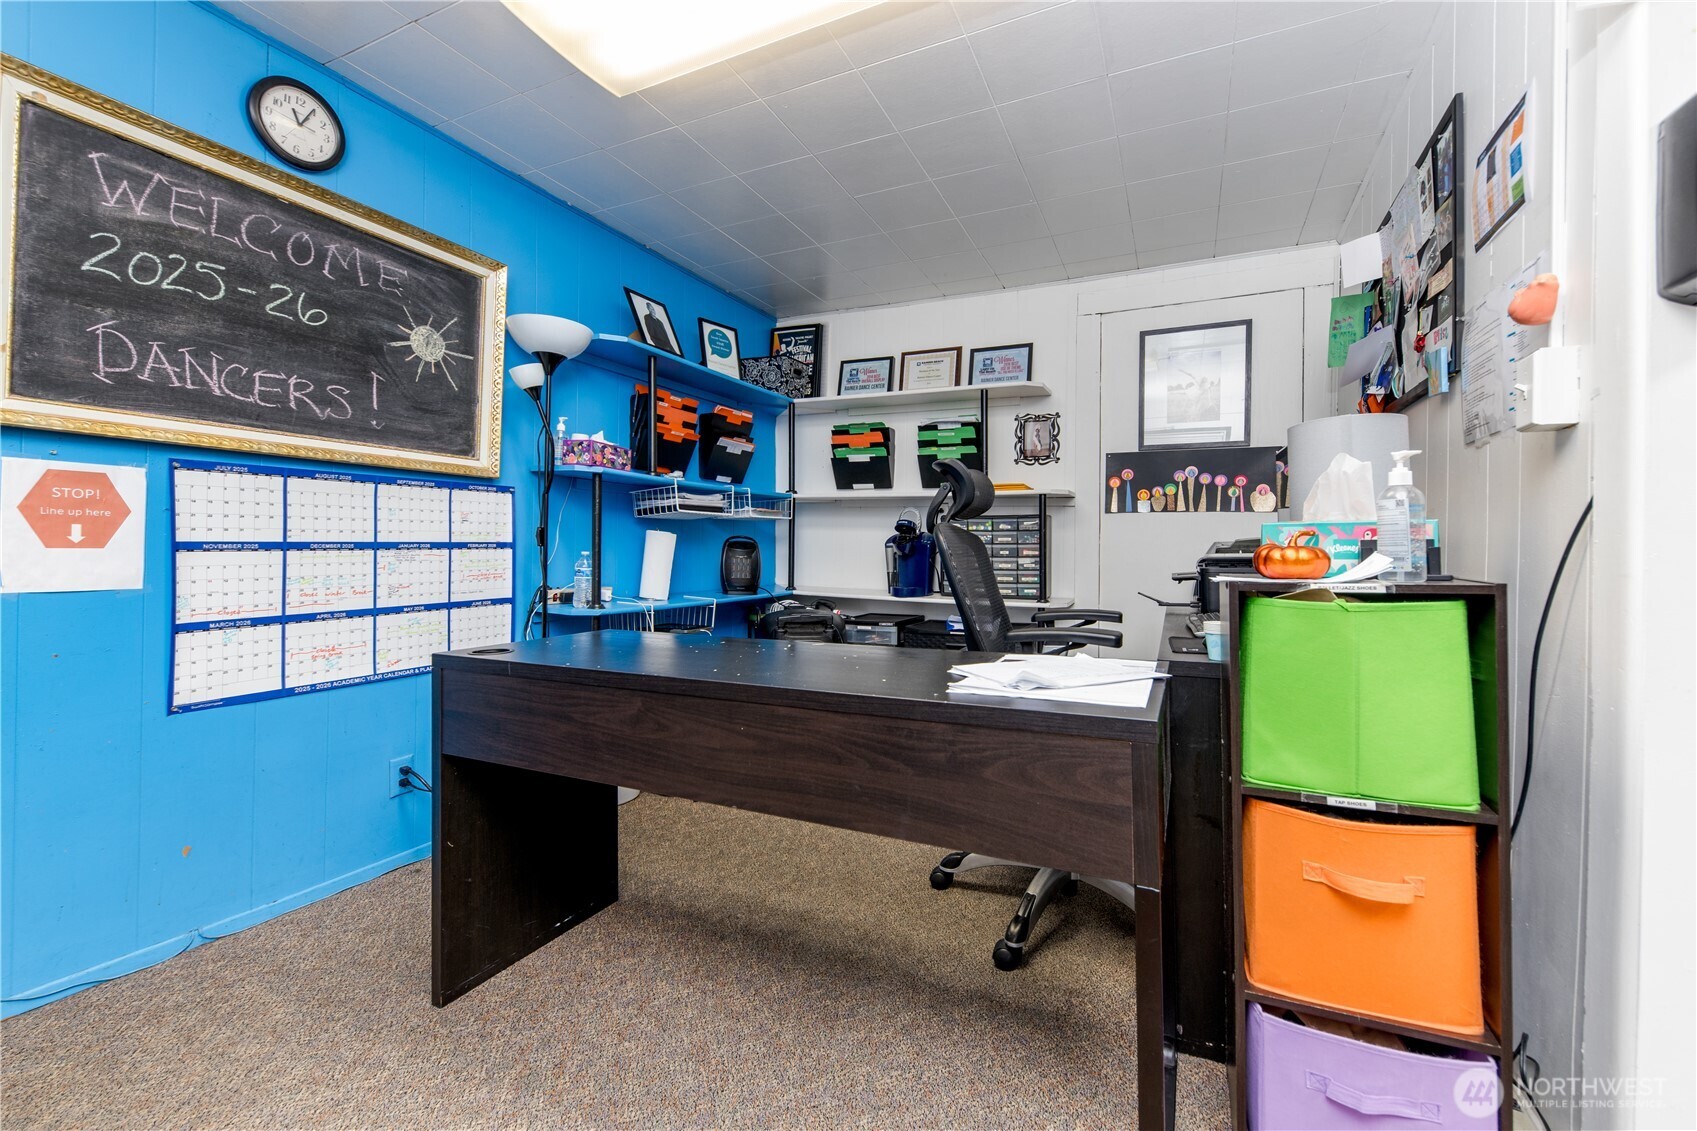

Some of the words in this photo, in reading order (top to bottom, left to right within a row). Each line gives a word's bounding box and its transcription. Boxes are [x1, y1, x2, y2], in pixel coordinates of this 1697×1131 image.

[273, 97, 283, 108] 10
[284, 94, 291, 104] 11
[296, 96, 306, 108] 12
[265, 106, 272, 116] 9
[269, 121, 276, 131] 8
[320, 120, 326, 130] 2
[281, 135, 288, 144] 7
[324, 134, 330, 144] 3
[293, 144, 300, 154] 6
[308, 148, 314, 158] 5
[89, 151, 411, 296] WELCOME
[792, 345, 812, 354] FESTIVAL
[52, 487, 100, 499] STOP!
[40, 506, 64, 516] Line
[68, 508, 82, 516] up
[86, 508, 112, 516] here
[332, 677, 366, 687] ACADEMIC
[384, 668, 414, 678] CALENDAR
